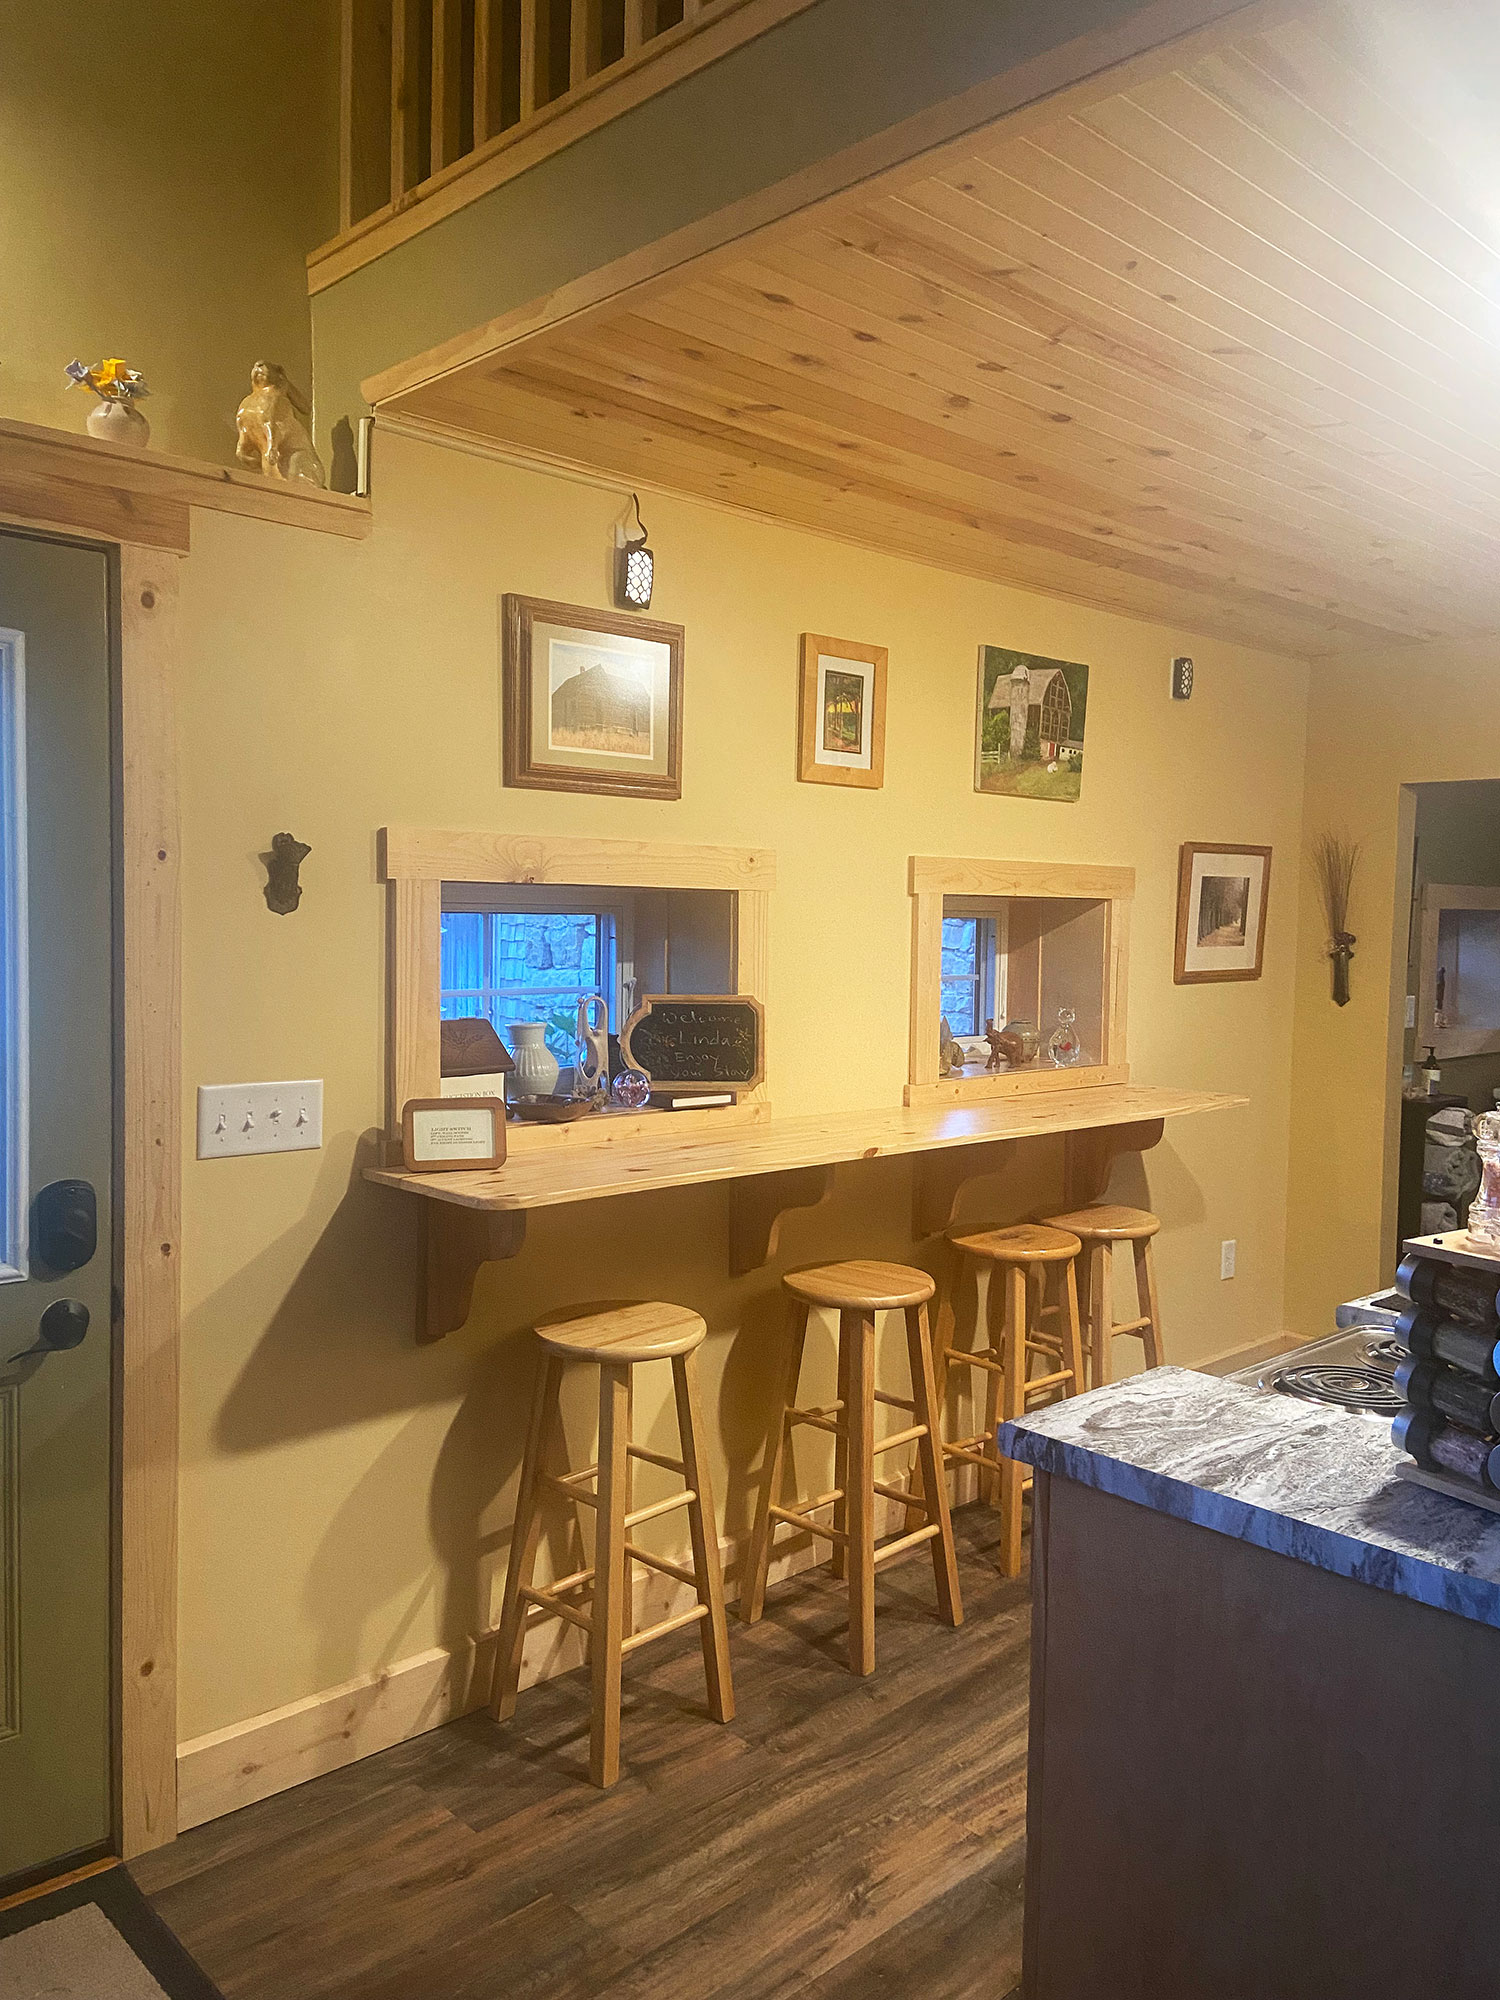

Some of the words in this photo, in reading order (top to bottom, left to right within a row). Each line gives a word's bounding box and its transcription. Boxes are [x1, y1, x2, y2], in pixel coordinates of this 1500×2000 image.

[662, 1010, 741, 1025] Welcome
[679, 1029, 731, 1047] Linda
[674, 1051, 720, 1069] Enjoy
